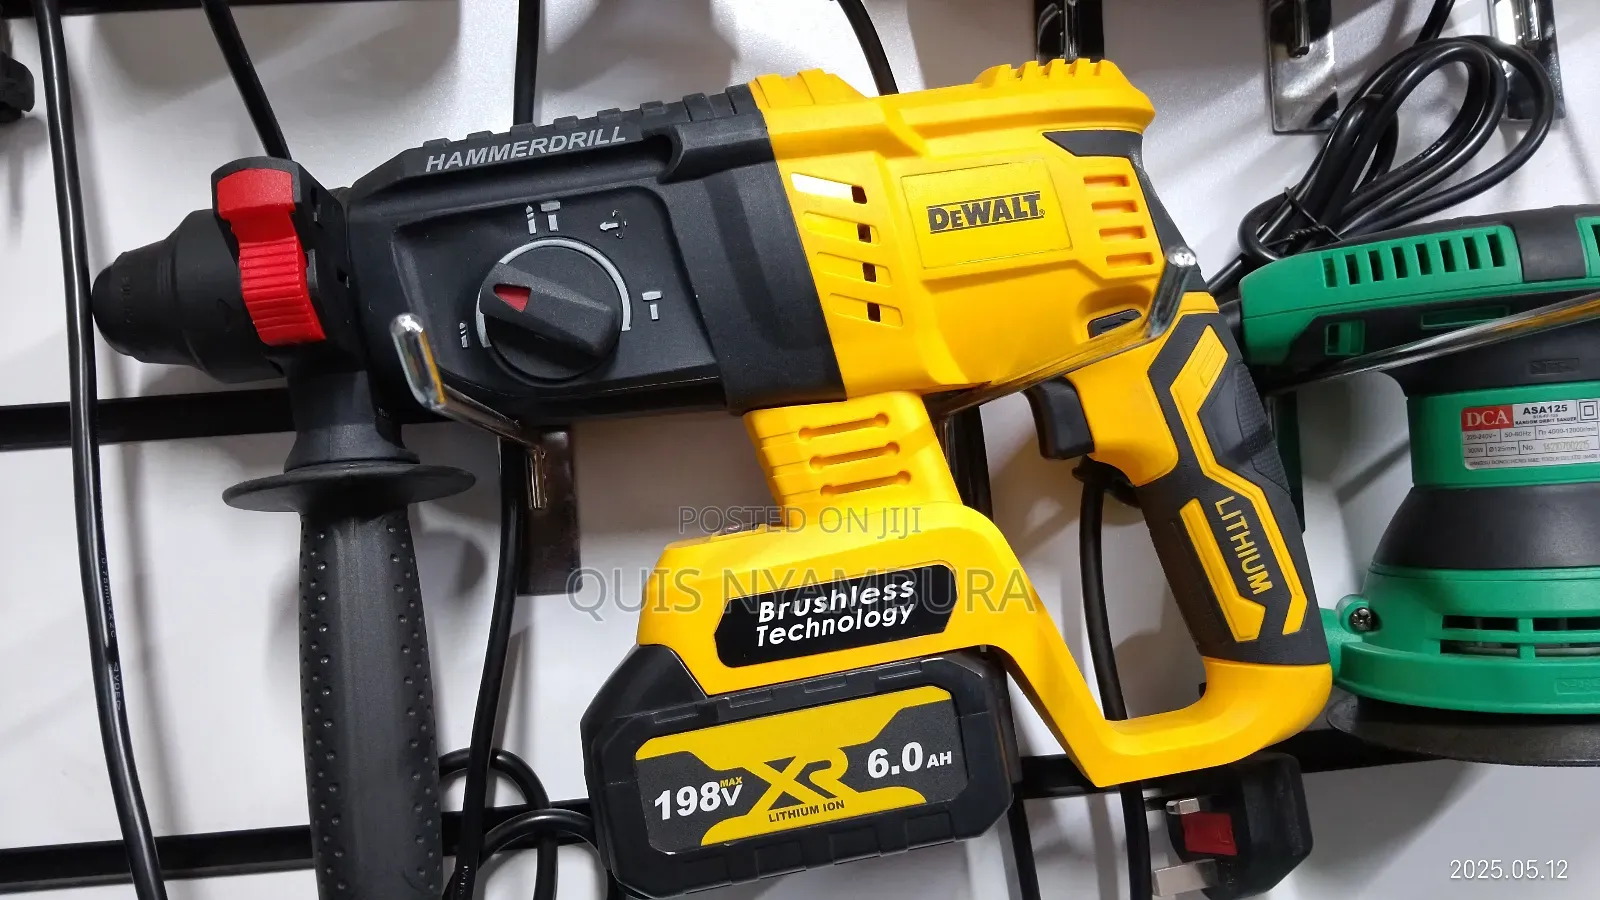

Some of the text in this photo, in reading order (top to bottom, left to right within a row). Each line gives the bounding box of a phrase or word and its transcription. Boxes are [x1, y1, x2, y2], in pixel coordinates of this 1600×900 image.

[425, 126, 626, 173] HAMMERDRILL
[1466, 409, 1510, 427] DCA
[1522, 404, 1568, 416] ASA125
[1504, 430, 1532, 438] 50-60Hz
[1522, 444, 1535, 452] No.
[1214, 495, 1273, 595] LITHIUM
[758, 580, 915, 623] Brushless
[756, 603, 915, 647] Technology
[867, 741, 952, 779] 6.0 AH
[719, 776, 743, 789] MAX
[654, 782, 743, 821] 198V
[768, 800, 845, 823] LITHIUM ION
